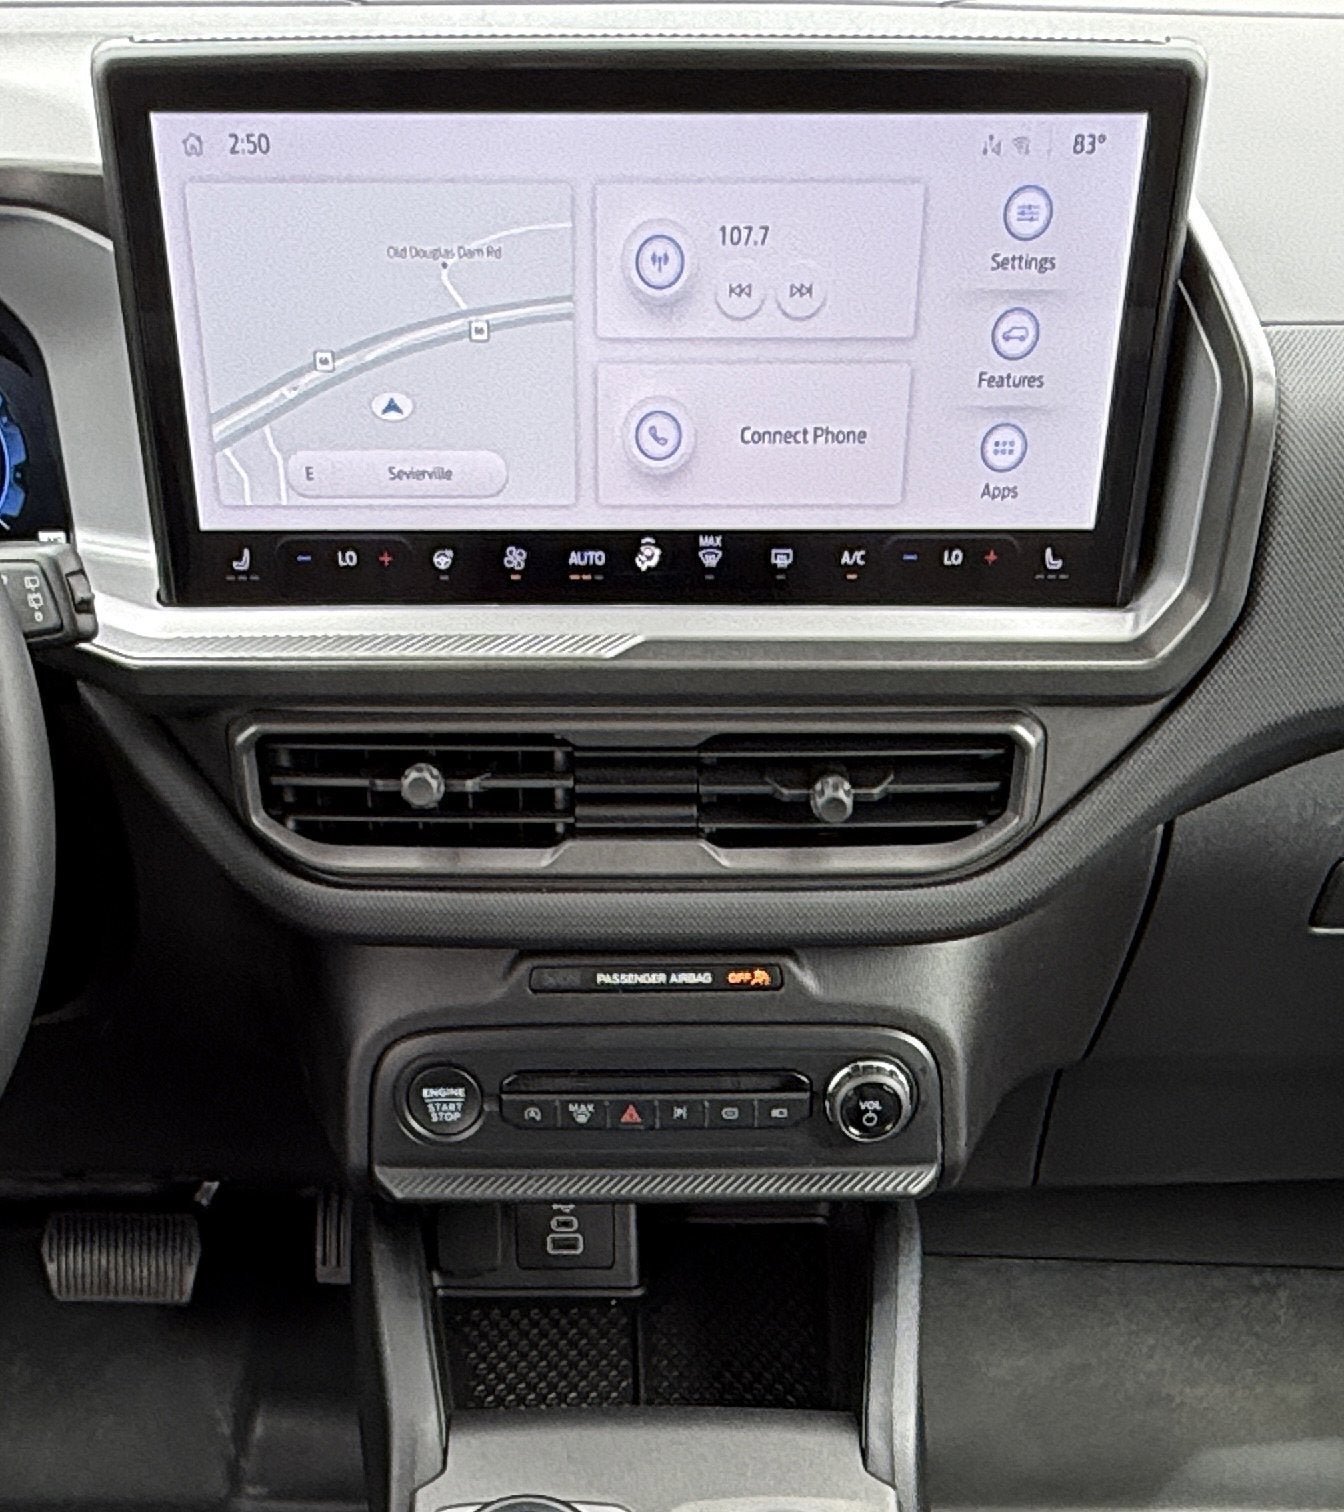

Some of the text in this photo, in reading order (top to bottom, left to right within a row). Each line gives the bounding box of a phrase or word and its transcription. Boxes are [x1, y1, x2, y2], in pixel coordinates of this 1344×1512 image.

[228, 132, 270, 155] 2:50
[1072, 133, 1108, 155] 83°
[719, 225, 770, 246] 107.7
[458, 246, 484, 259] Dam
[486, 245, 502, 259] Rd
[990, 253, 1056, 274] Settings
[977, 371, 1044, 388] Features
[740, 426, 867, 445] Connect Phone
[305, 466, 315, 482] E
[388, 466, 454, 481] Sevierville
[980, 483, 1019, 500] Apps
[699, 535, 723, 547] MAX
[337, 550, 357, 567] LO
[568, 550, 606, 566] AUTO
[841, 549, 866, 566] A/C
[943, 549, 963, 566] LO
[596, 973, 667, 985] PASSENGER
[669, 972, 712, 984] AIRBAG
[422, 1087, 466, 1098] ENGINE
[426, 1102, 463, 1112] START
[568, 1103, 595, 1112] MAX
[859, 1100, 882, 1110] VOL
[430, 1112, 461, 1122] STOP
